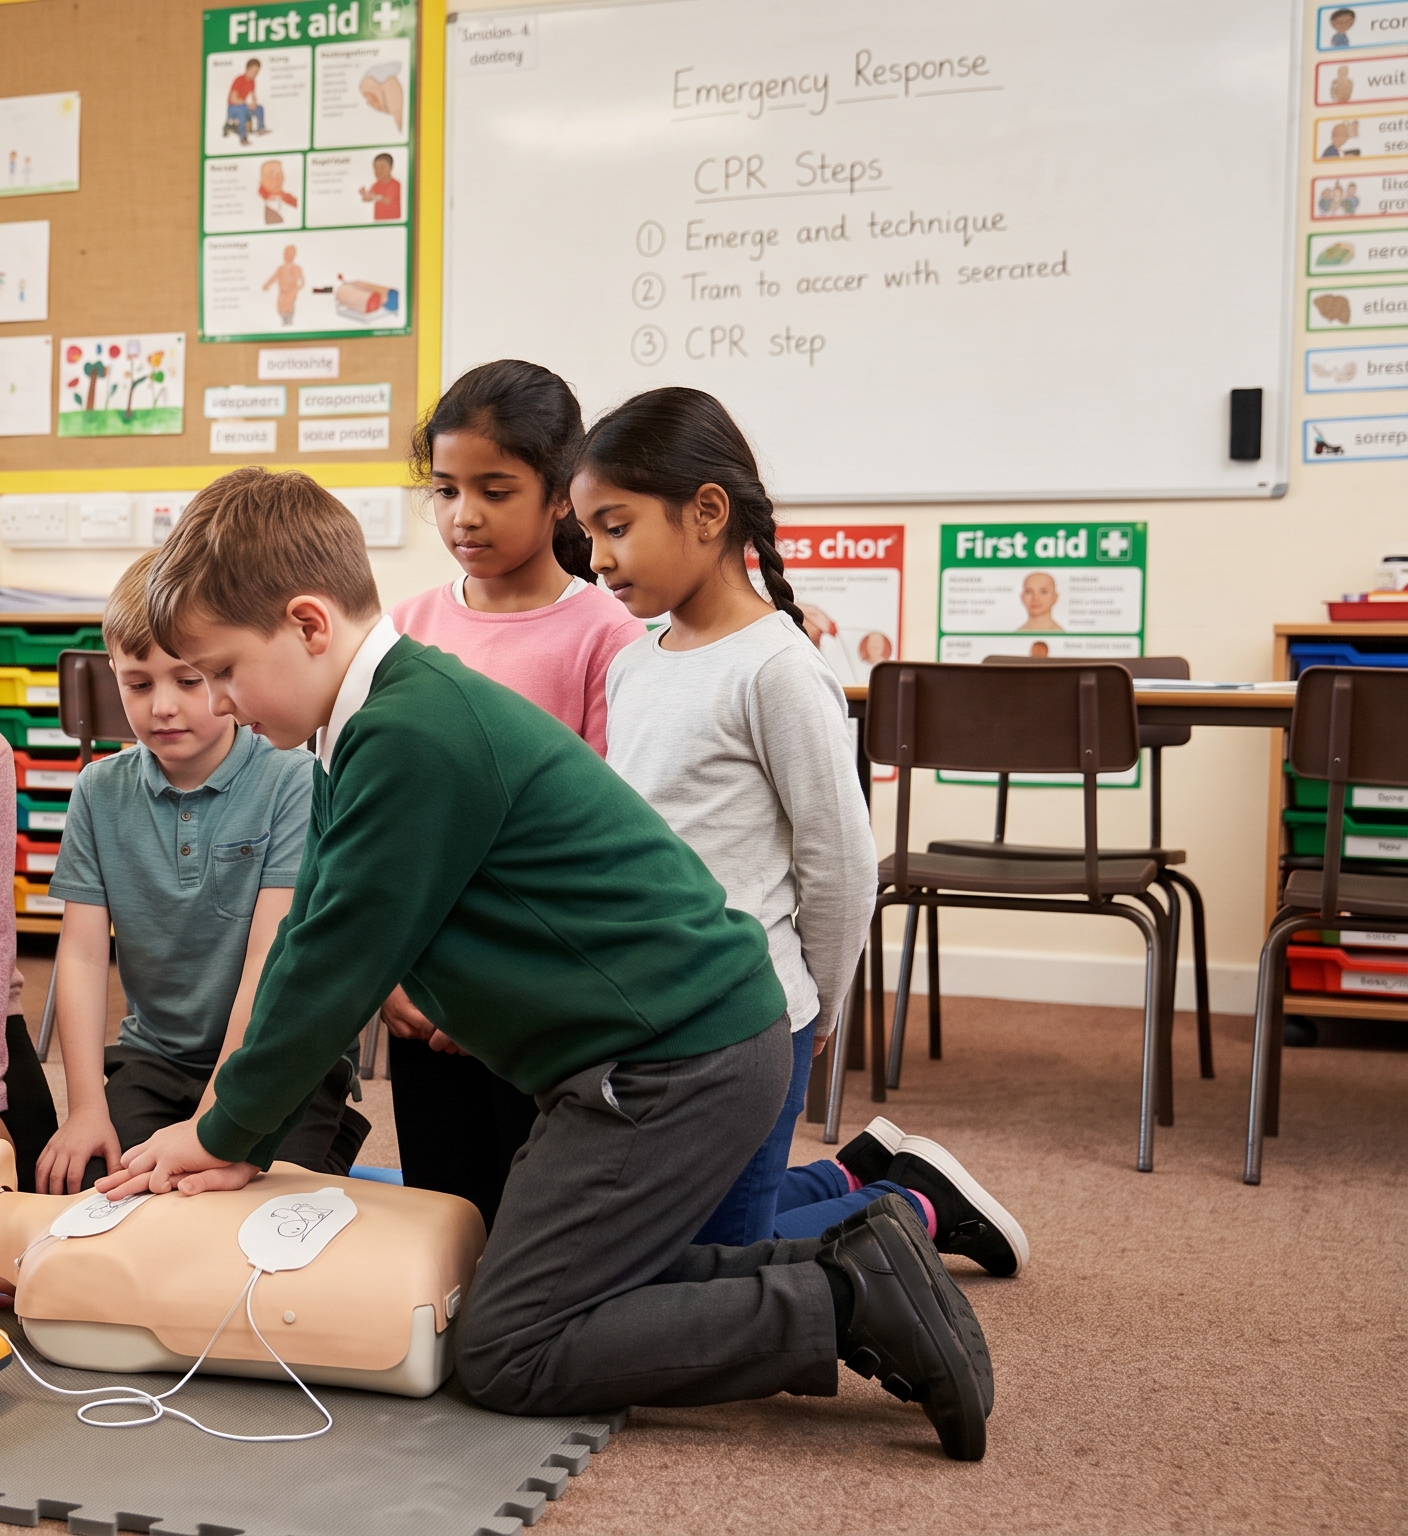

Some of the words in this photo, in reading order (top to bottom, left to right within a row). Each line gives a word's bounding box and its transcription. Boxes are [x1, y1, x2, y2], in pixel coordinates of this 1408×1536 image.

[229, 10, 301, 45] First
[307, 1, 359, 38] aid
[673, 66, 829, 119] Emergency
[854, 49, 990, 96] Response
[694, 153, 768, 194] CPR
[795, 150, 884, 194] Steps
[685, 218, 779, 262] Emerge
[796, 213, 850, 244] and
[867, 210, 1008, 247] technique
[680, 271, 742, 301] Tram
[756, 270, 781, 297] to
[884, 258, 940, 289] with
[685, 323, 749, 360] CPR
[768, 325, 827, 367] step
[819, 530, 895, 560] chor
[956, 530, 1028, 559] First
[1034, 528, 1088, 559] aid
